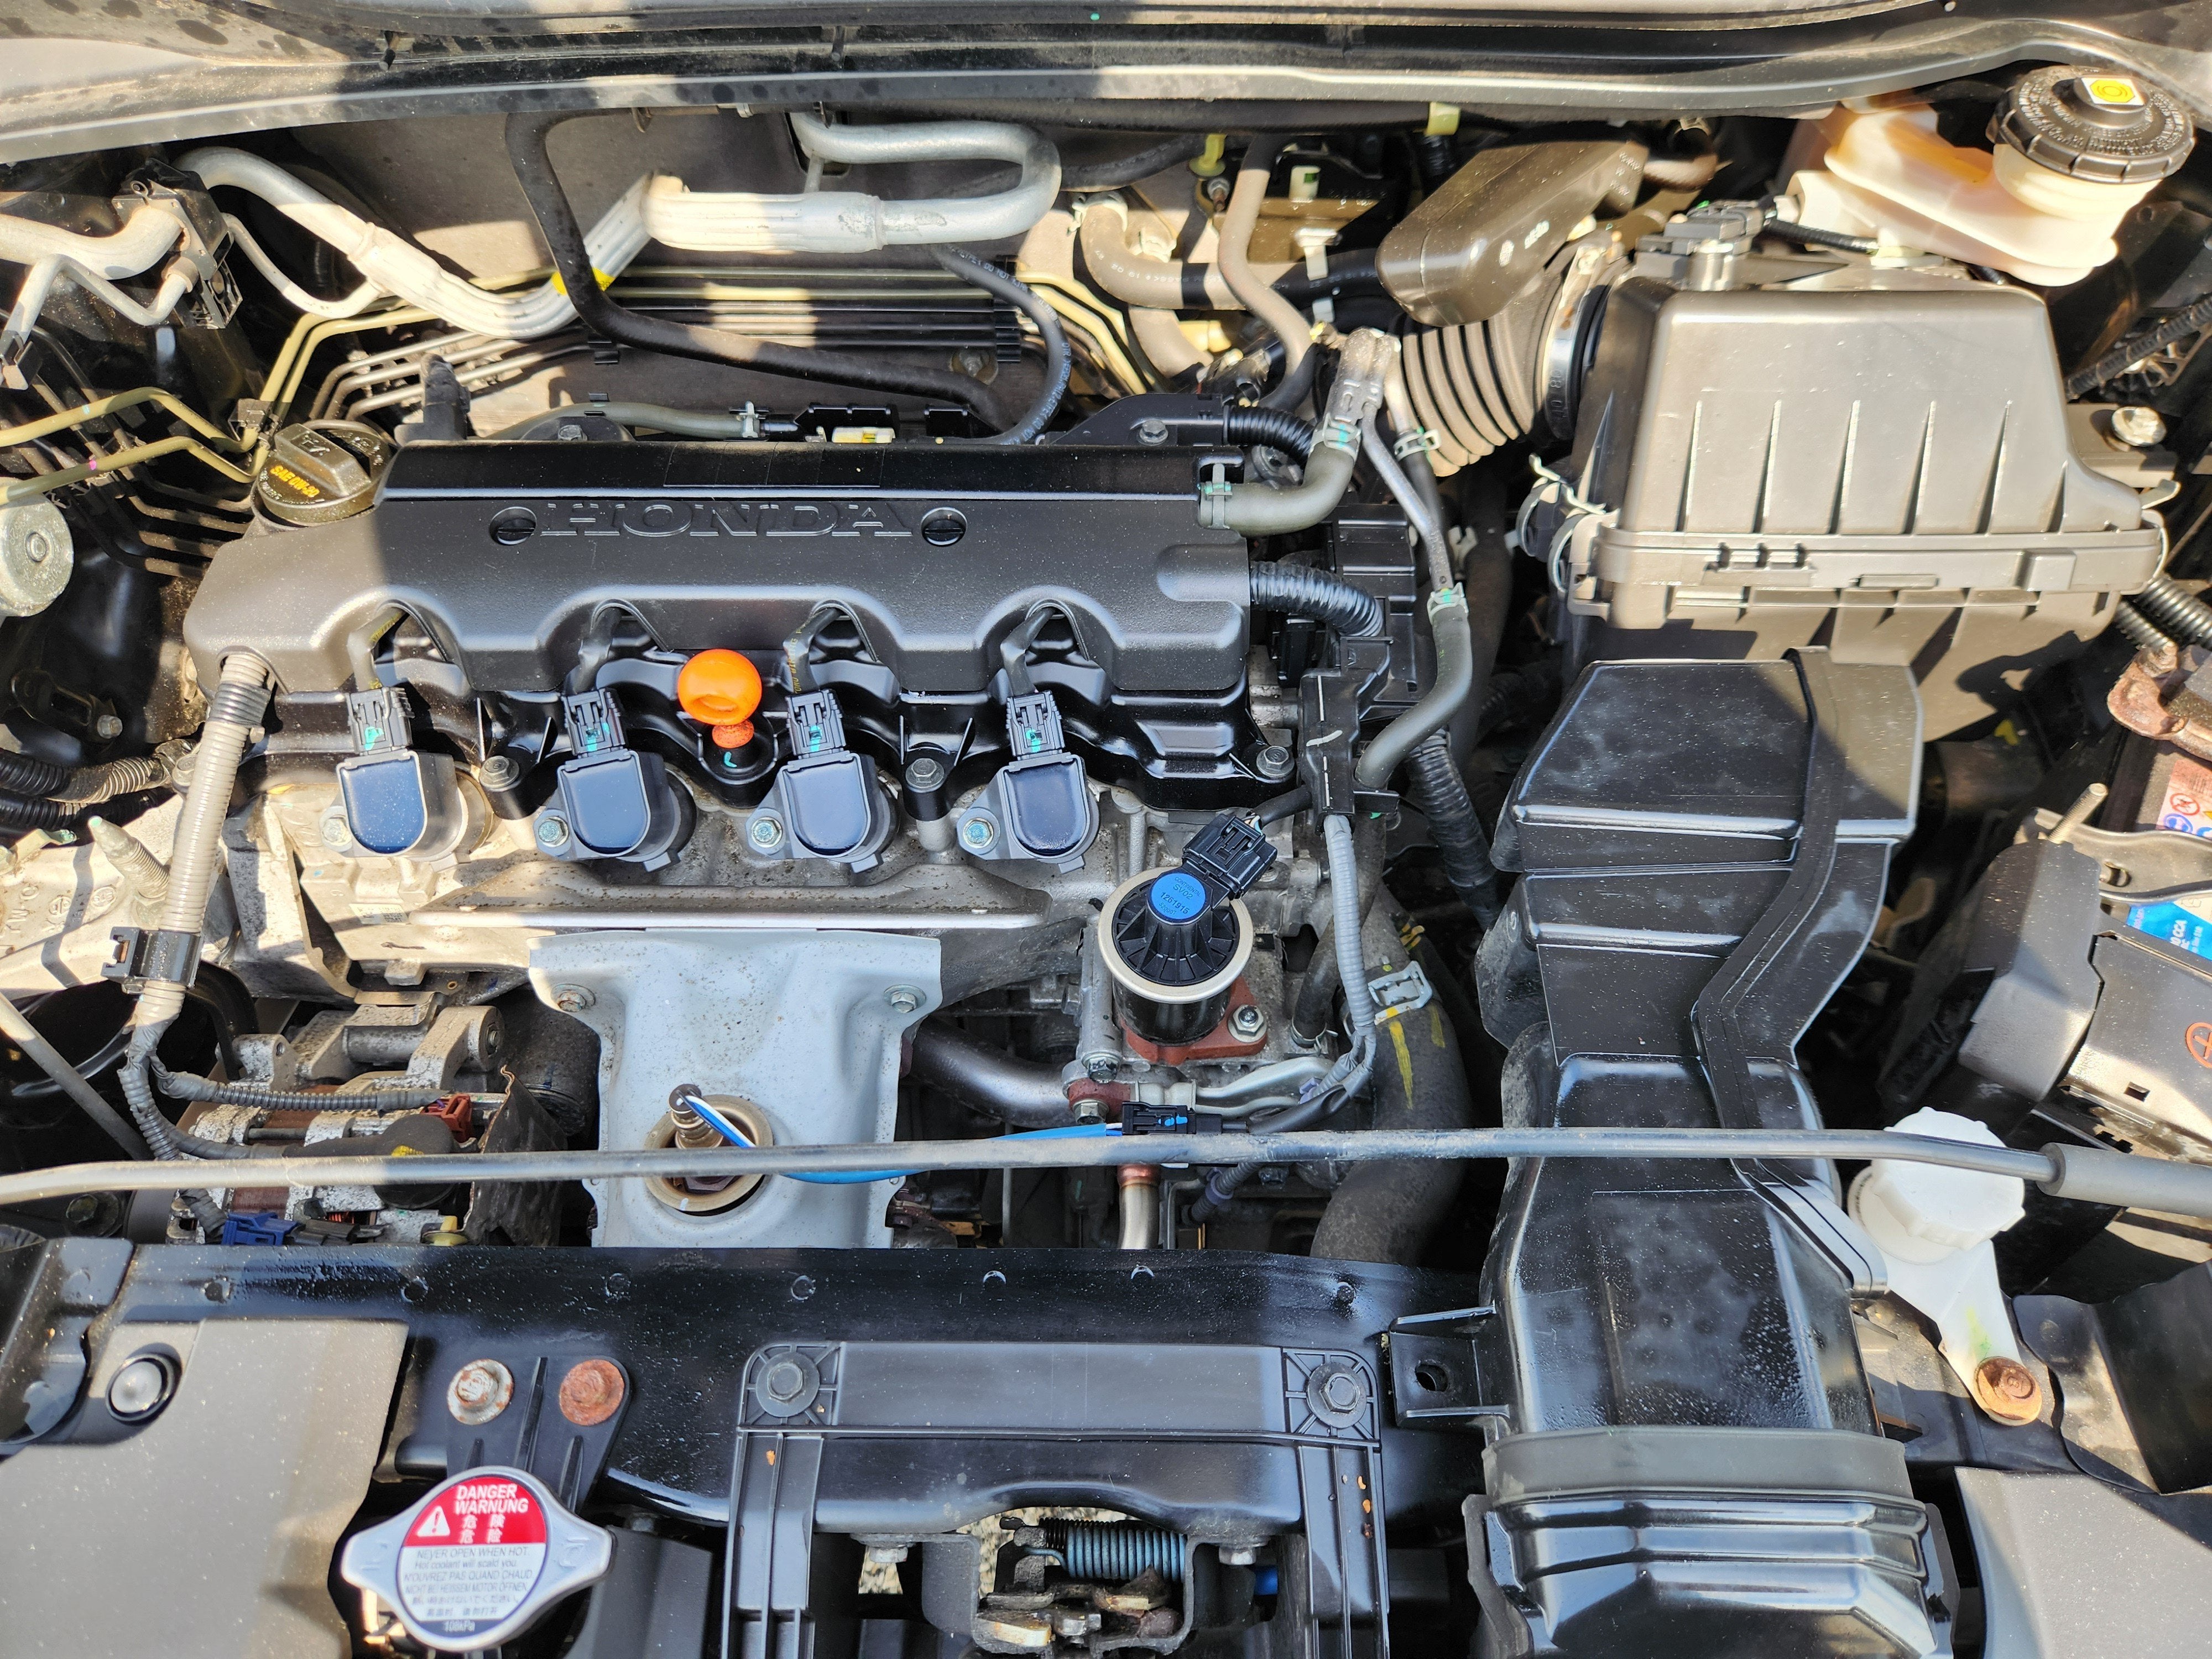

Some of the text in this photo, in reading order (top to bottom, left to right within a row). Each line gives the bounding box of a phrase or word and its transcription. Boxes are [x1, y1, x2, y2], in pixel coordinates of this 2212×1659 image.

[270, 465, 295, 482] SAE
[288, 476, 320, 498] 0W-20
[540, 503, 914, 537] HONDA
[1173, 884, 1193, 900] SV02
[1174, 876, 1201, 897] CONTINENTAL
[1160, 891, 1190, 914] 1261915
[457, 1484, 518, 1499] DANGER
[455, 1498, 529, 1514] WARNUNG
[417, 1549, 448, 1559] NEVER
[450, 1548, 476, 1558] OPEN
[478, 1547, 507, 1557] WHEN
[415, 1561, 429, 1569] Hot
[431, 1560, 460, 1569] coolant
[463, 1559, 474, 1568] will
[477, 1558, 499, 1567] scald
[449, 1572, 466, 1580] PAS
[468, 1571, 500, 1580] QUAND
[472, 1582, 498, 1592] MOTOR
